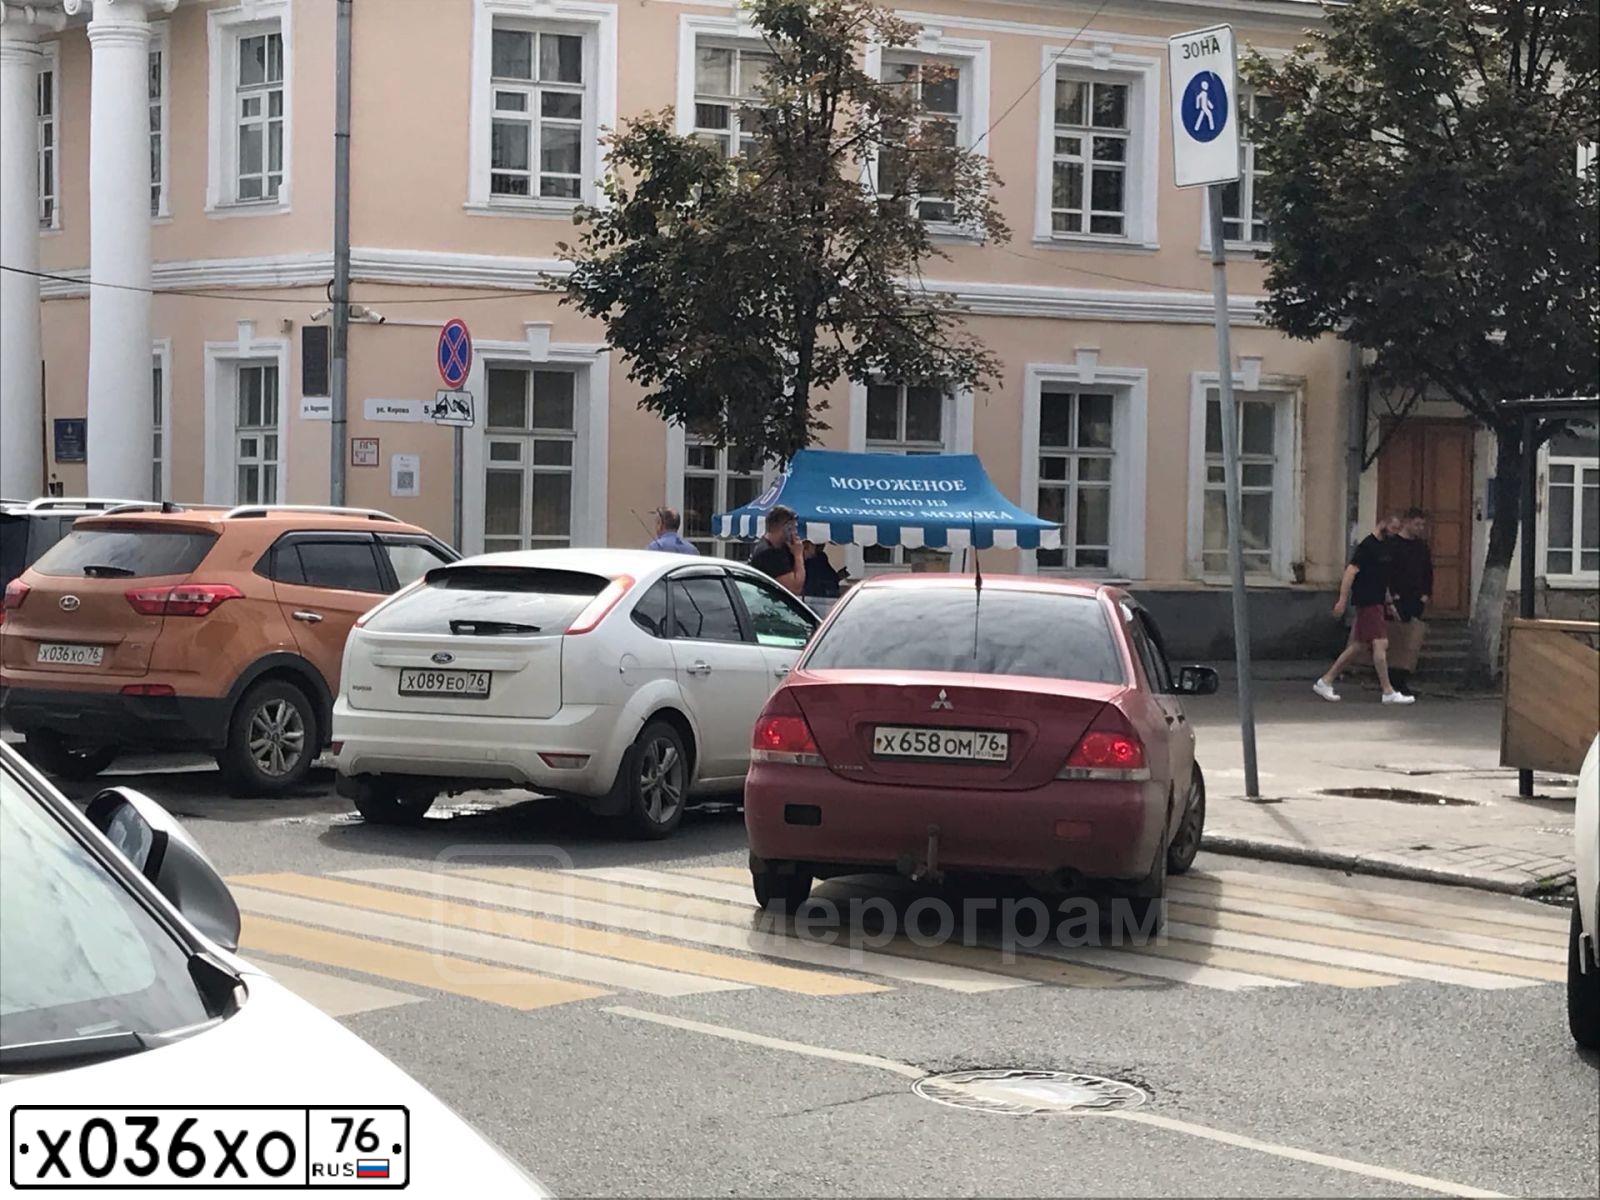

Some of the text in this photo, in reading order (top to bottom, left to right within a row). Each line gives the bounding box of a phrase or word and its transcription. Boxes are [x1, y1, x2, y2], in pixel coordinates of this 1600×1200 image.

[1182, 36, 1221, 59] ЗОНА
[829, 476, 967, 492] МОРОЖЕНОЕ
[861, 497, 948, 507] ТОЛЬКО ИЗ
[815, 505, 1014, 520] СВЕЖЕГО МОЛОКА
[88, 647, 99, 660] 76
[470, 673, 484, 687] 76
[883, 731, 1000, 755] Х658ОМ 76
